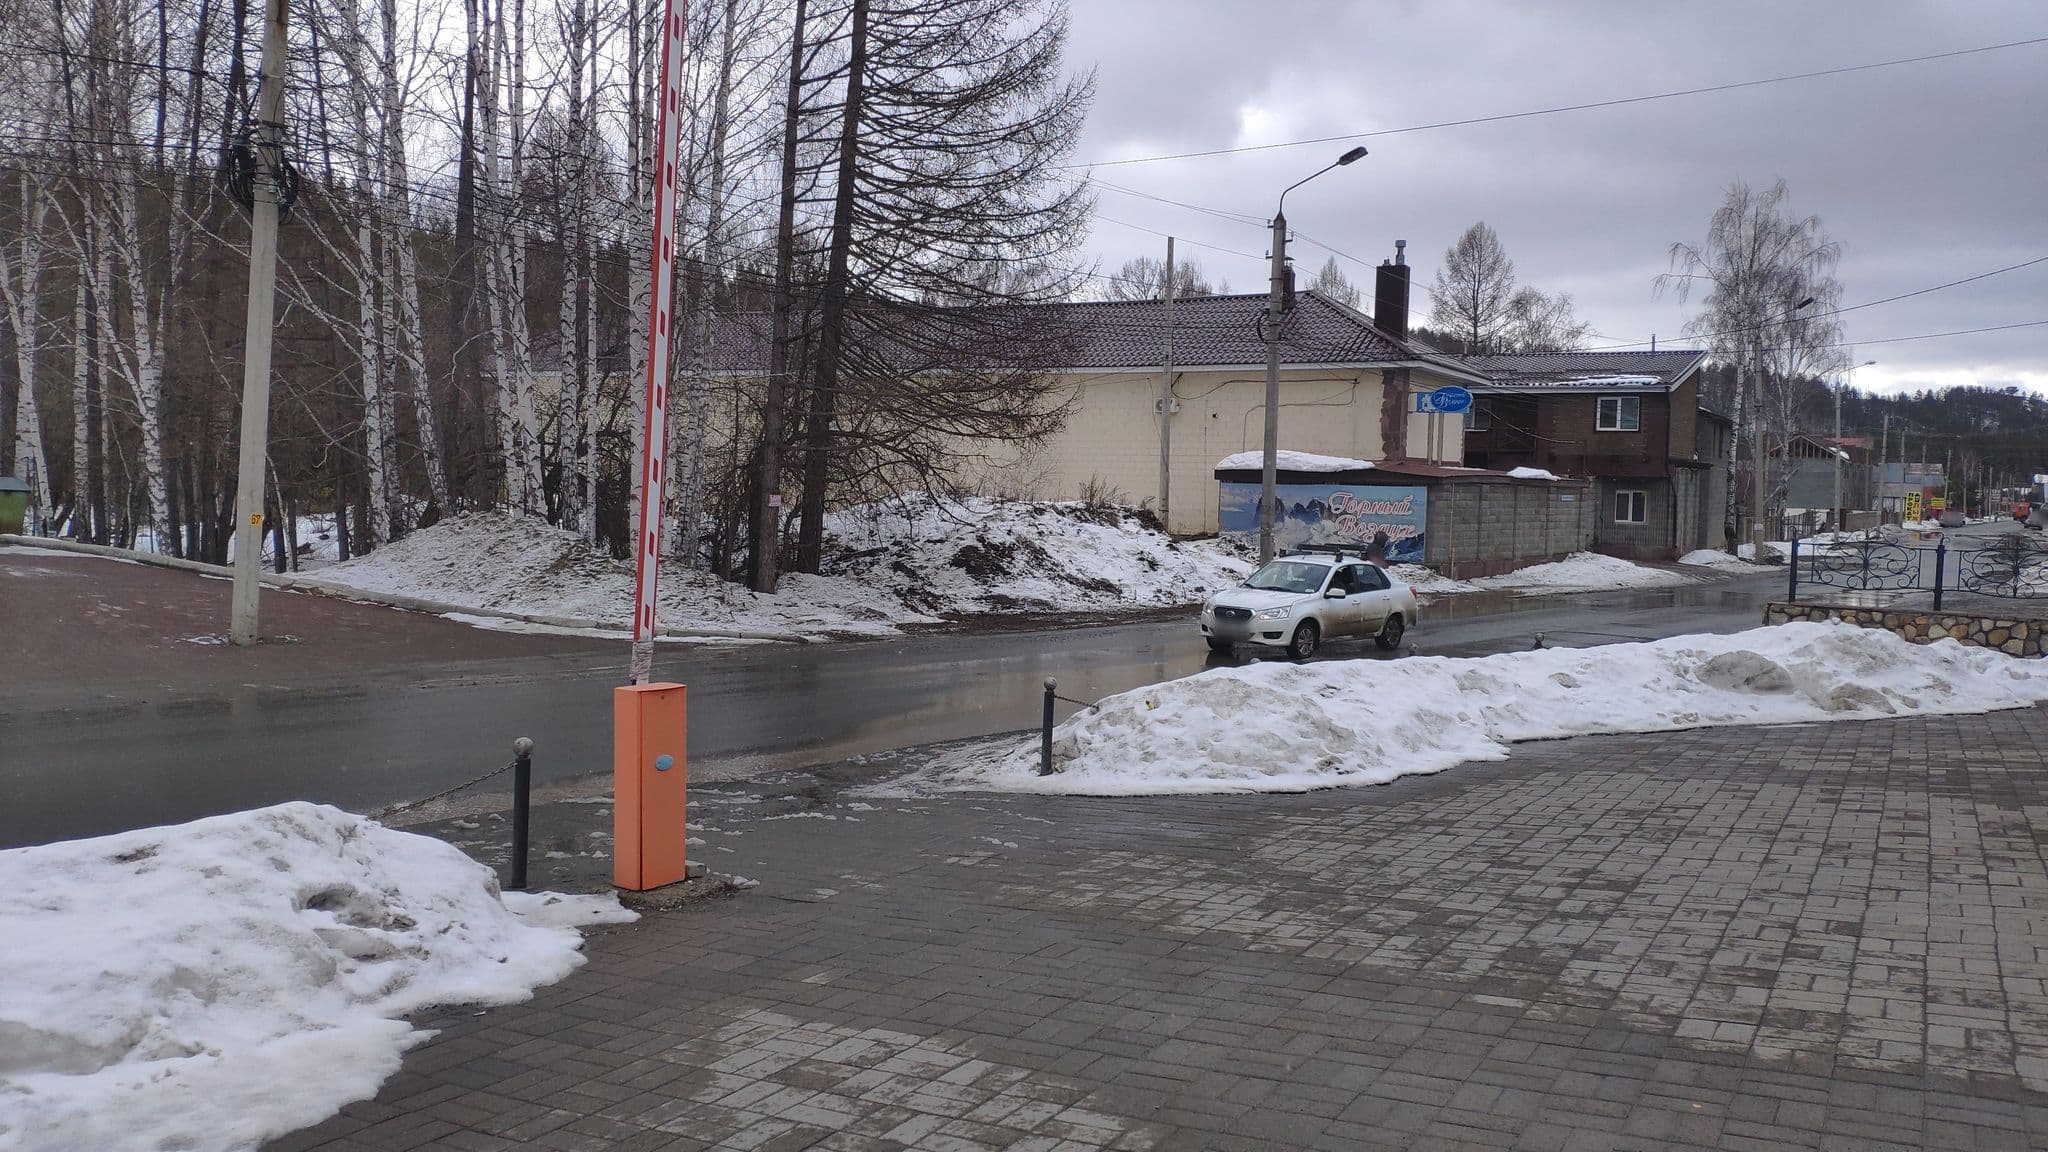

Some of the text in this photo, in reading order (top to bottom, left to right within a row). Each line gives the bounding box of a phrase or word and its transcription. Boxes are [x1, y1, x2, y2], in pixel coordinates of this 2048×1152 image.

[1329, 491, 1413, 518] Горный
[1906, 492, 1914, 520] ПРОКАТ
[251, 514, 261, 525] 67
